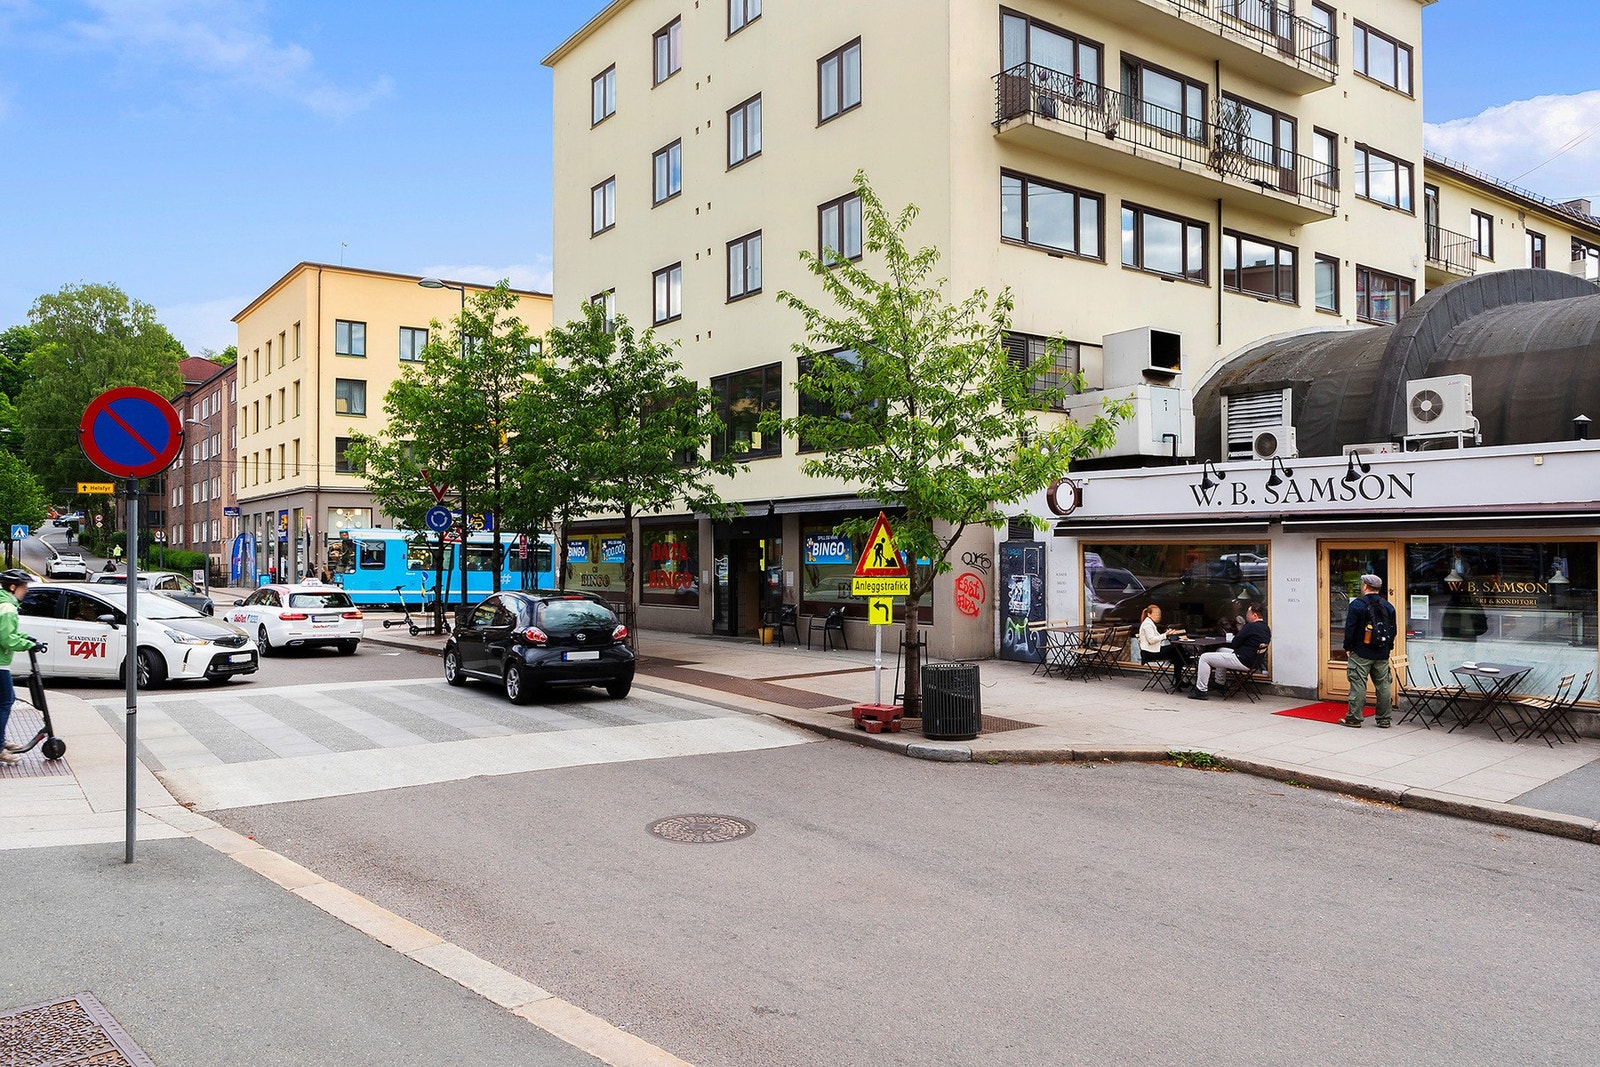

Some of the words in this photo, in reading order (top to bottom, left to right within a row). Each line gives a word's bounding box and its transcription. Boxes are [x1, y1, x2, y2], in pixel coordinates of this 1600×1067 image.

[1190, 483, 1222, 507] W.
[1231, 482, 1256, 506] B.
[1264, 472, 1415, 505] SAMSON
[568, 546, 586, 557] BINGO
[651, 542, 689, 561] DATA
[812, 541, 844, 556] BINGO
[581, 574, 611, 587] BINGO
[648, 570, 692, 589] BINGO
[854, 580, 909, 593] Anleggstrafikk
[1482, 581, 1548, 594] SAMSON
[67, 638, 107, 659] TAXI
